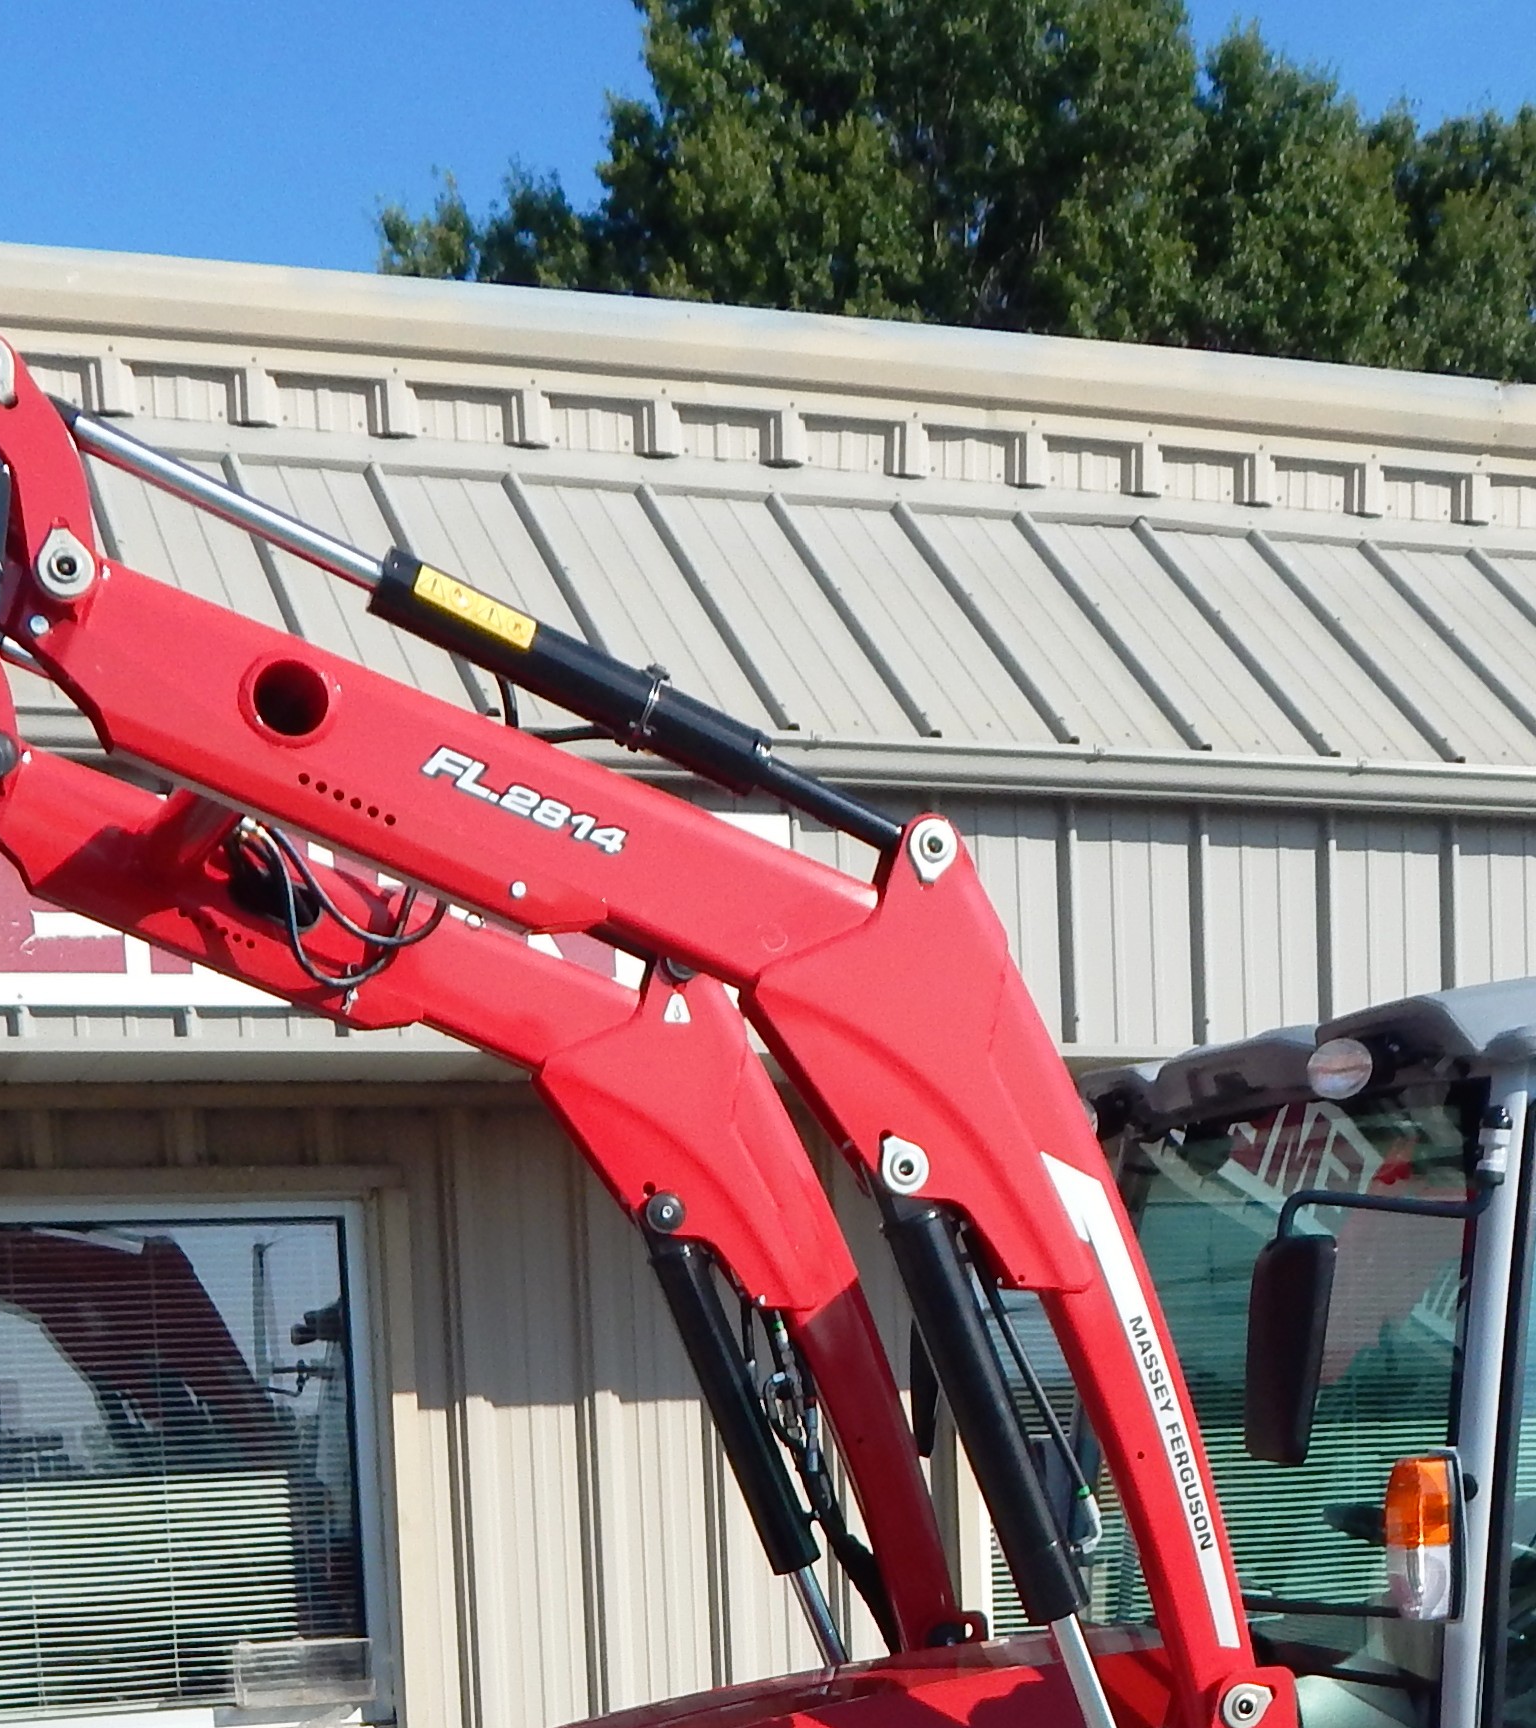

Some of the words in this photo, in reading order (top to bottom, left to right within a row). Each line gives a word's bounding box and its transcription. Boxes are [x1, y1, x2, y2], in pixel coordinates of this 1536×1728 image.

[421, 744, 630, 856] FL.2814
[1128, 1314, 1176, 1413] MASSEY
[1164, 1420, 1215, 1551] FERGUSON
